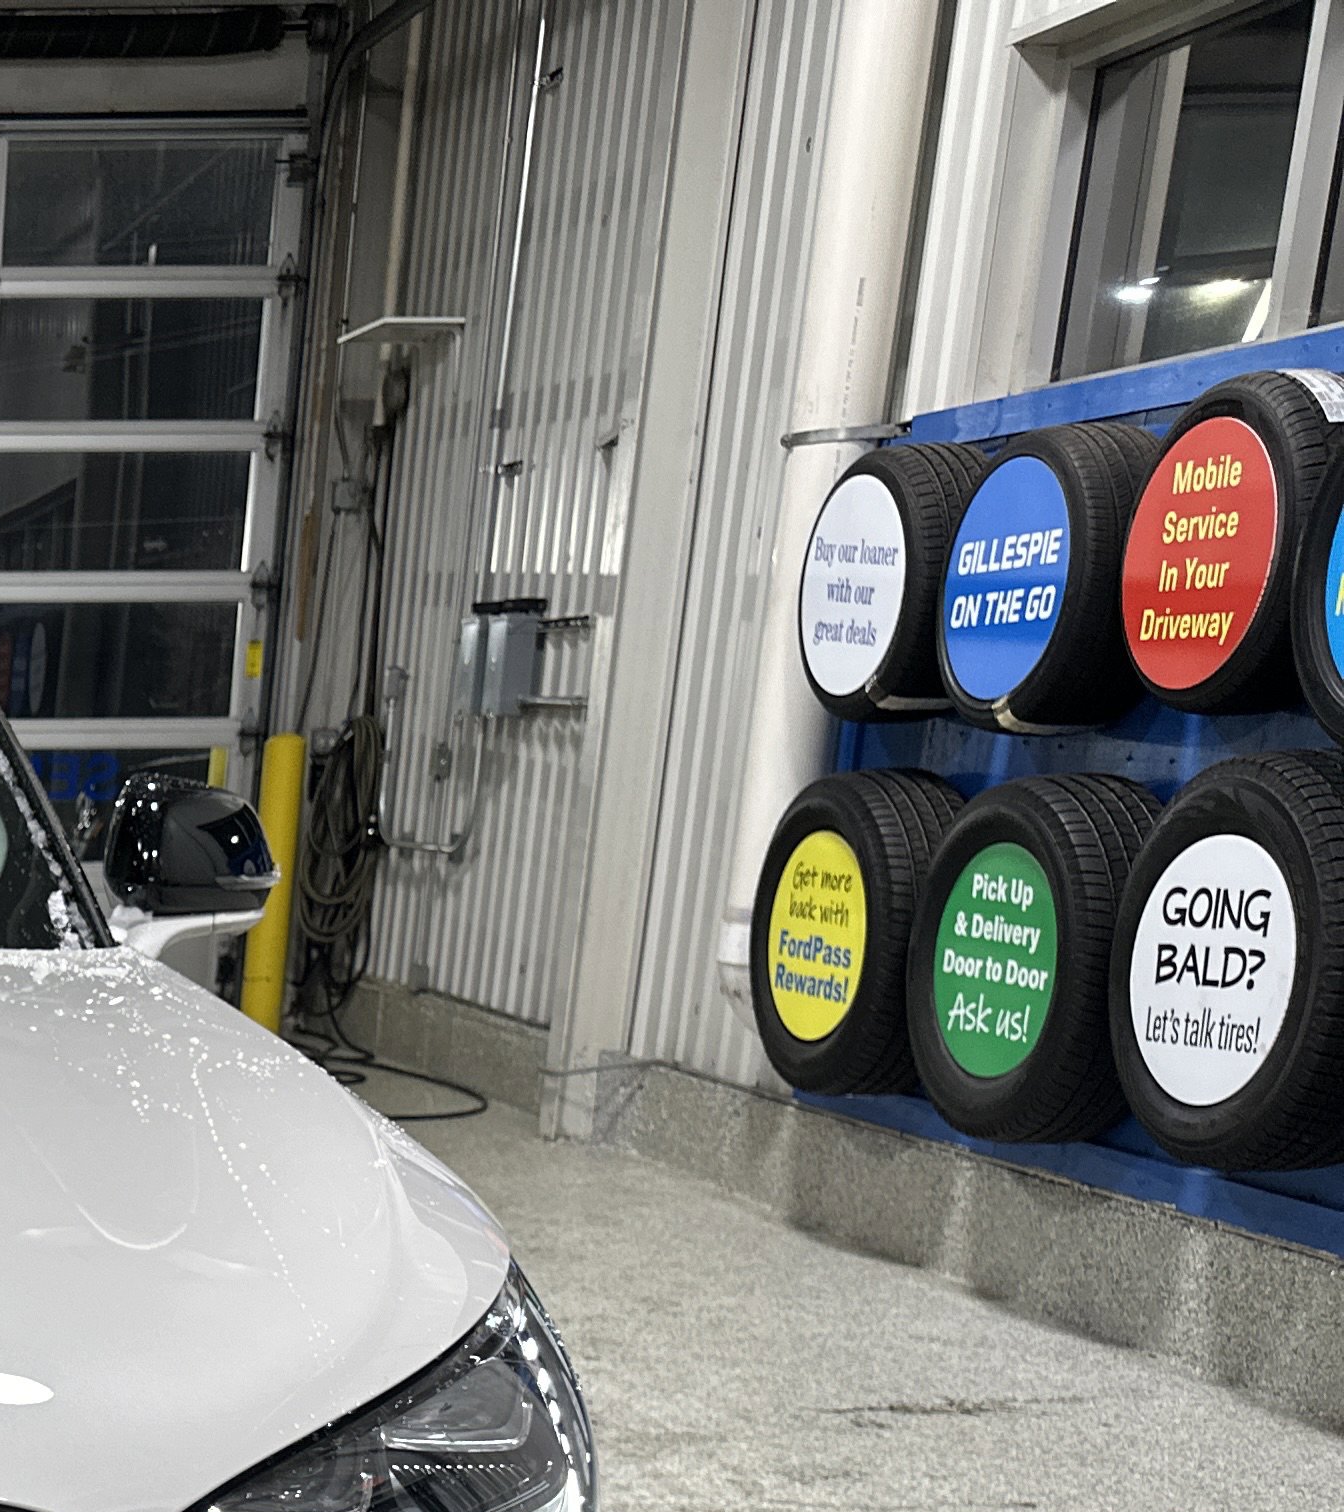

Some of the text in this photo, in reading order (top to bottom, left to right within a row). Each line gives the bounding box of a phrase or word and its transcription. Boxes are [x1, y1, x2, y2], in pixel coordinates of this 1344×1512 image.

[1172, 454, 1243, 495] Mobile
[1161, 506, 1239, 545] Service
[814, 536, 898, 568] Buy our loaner
[958, 528, 1063, 576] GILLESPIE
[827, 578, 875, 605] with our
[1158, 558, 1230, 592] In Your
[950, 584, 1056, 629] ON THE GO
[812, 618, 877, 647] great deals
[1138, 608, 1235, 646] Driveway
[792, 861, 853, 893] Get more
[972, 873, 1034, 911] Pick Up
[789, 893, 849, 927] back with
[1161, 886, 1272, 937] GOING
[778, 929, 852, 968] FordPass
[954, 910, 1041, 954] & Delivery
[774, 963, 849, 1003] Rewards!
[942, 948, 1048, 991] Door to Door
[1155, 944, 1266, 991] BALD?
[947, 992, 1031, 1043] Ask us!
[1145, 1006, 1261, 1054] Let's talk tires!
